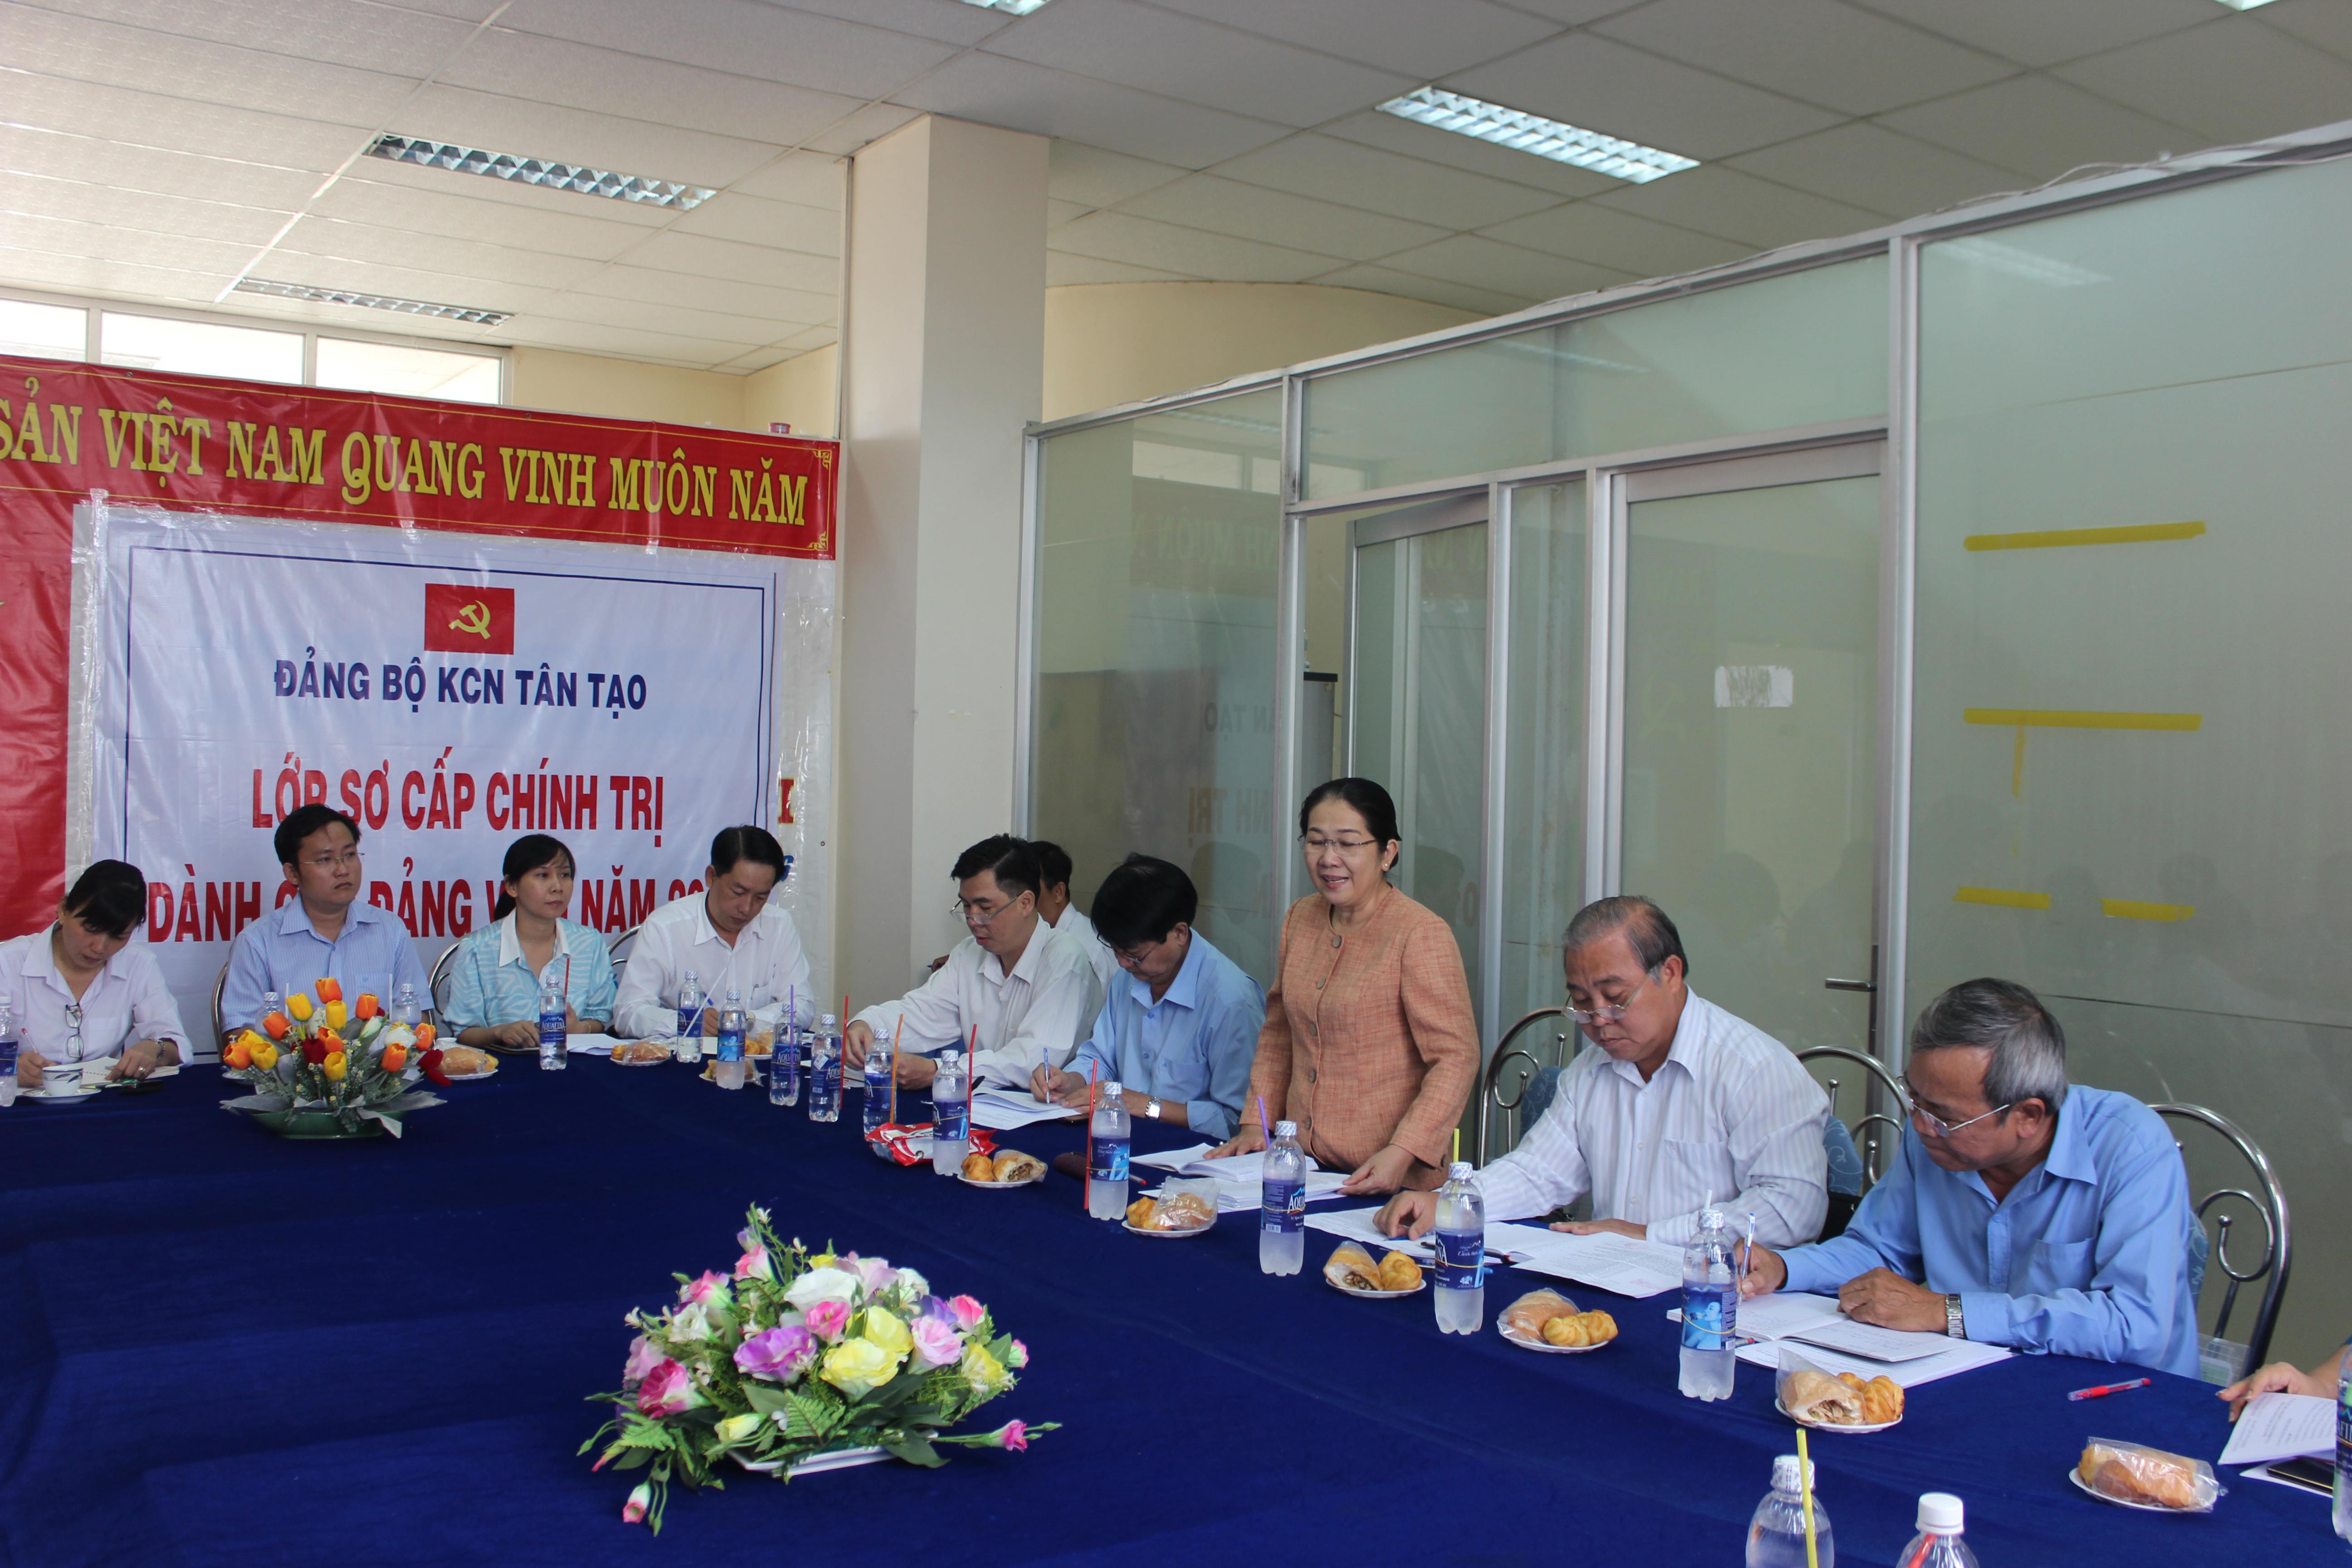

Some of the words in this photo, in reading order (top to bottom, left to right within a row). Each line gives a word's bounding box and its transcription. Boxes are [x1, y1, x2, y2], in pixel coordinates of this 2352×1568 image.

[98, 397, 211, 488] VIỆT
[225, 421, 327, 485] NAM
[341, 431, 485, 505] QUANG
[499, 446, 597, 508] VINH
[608, 447, 718, 517] MUÔN
[728, 456, 808, 526] NĂM
[274, 646, 370, 701] ĐẢNG
[382, 656, 426, 713] BỘ
[437, 667, 504, 705] KCN
[514, 662, 578, 707] TÂN
[587, 672, 647, 720] TẠO
[339, 759, 390, 830] SƠ
[402, 746, 475, 831] CẤP
[486, 757, 598, 831] CHÍNH
[609, 775, 664, 848] TRỊ
[148, 863, 261, 943] DÀNH
[581, 865, 656, 933] NĂM
